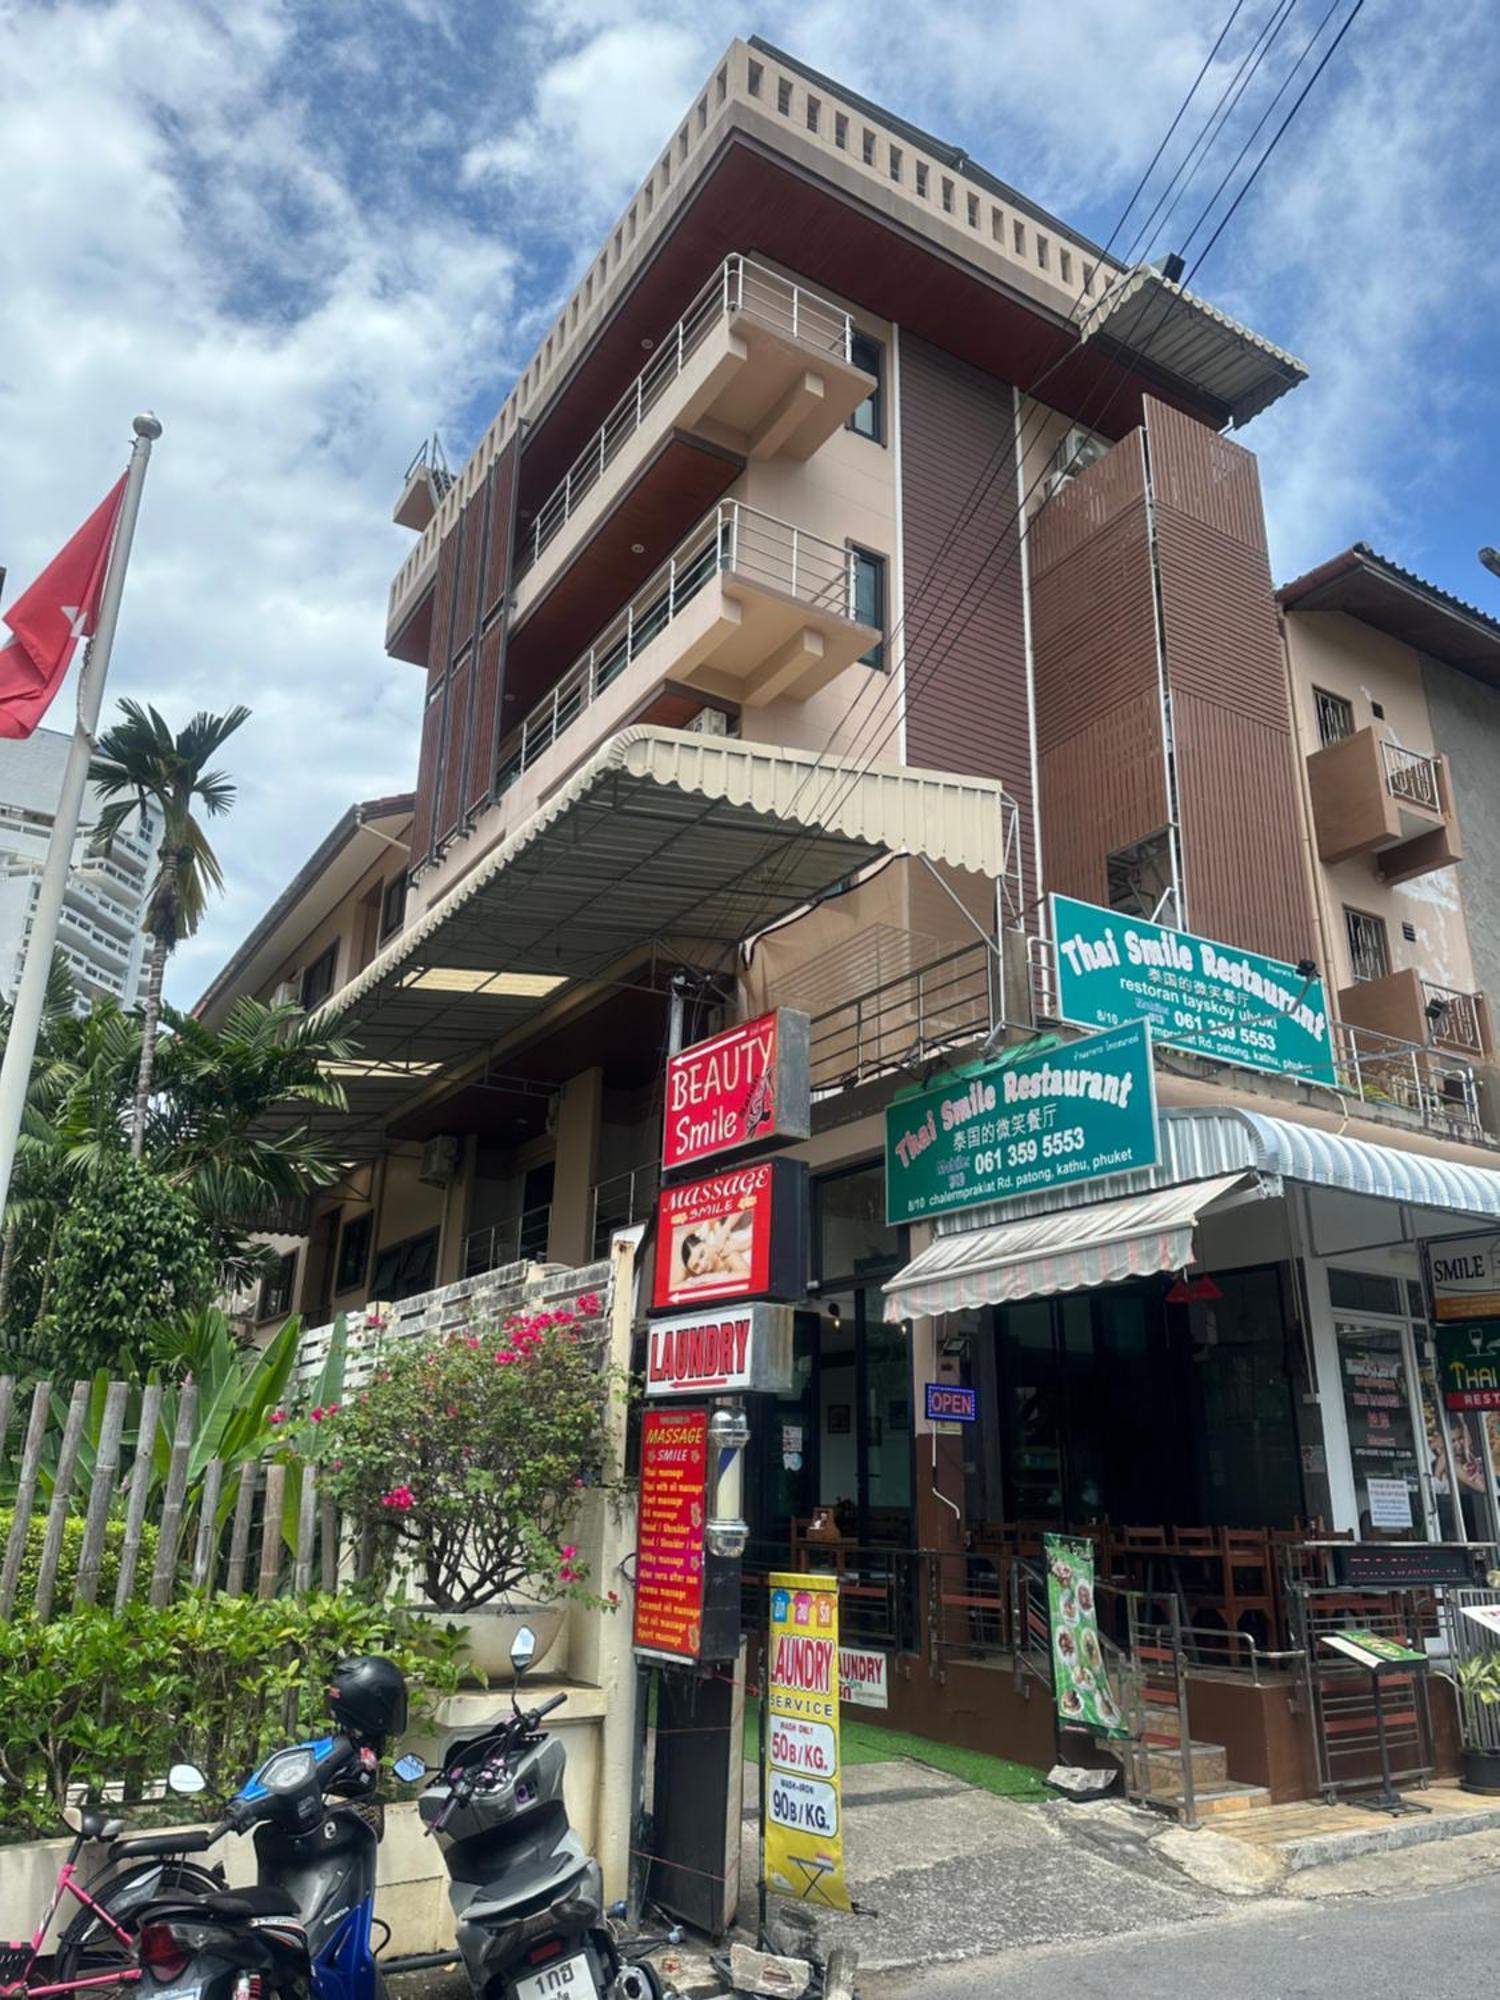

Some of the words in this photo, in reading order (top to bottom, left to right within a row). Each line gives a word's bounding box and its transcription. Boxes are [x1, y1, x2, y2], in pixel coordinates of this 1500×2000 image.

[1060, 927, 1121, 976] Thai
[1124, 929, 1194, 972] Smile
[1096, 1008, 1119, 1025] 8/10
[1119, 977, 1179, 1004] restoran
[1182, 991, 1235, 1021] tayskoy
[1173, 1010, 1203, 1031] 061
[1240, 1026, 1276, 1052] 5553
[671, 1031, 774, 1111] BEAUTY
[676, 1105, 737, 1156] Smile
[895, 1110, 937, 1168] Thai
[941, 1080, 996, 1131] Smile
[1003, 1062, 1133, 1109] Restaurant
[953, 1103, 1057, 1152] 泰国的微笑餐厅
[974, 1148, 1002, 1175] 061
[1007, 1139, 1038, 1167] 359
[1042, 1126, 1085, 1158] 5553
[997, 1176, 1013, 1190] Rd.
[1015, 1167, 1055, 1189] patong,
[1056, 1158, 1090, 1176] kathu,
[1092, 1148, 1133, 1170] phuket
[688, 1199, 734, 1220] SMILE
[1434, 1255, 1485, 1283] SMILE
[650, 1318, 750, 1383] LAUNDRY
[1449, 1361, 1498, 1390] THAI
[932, 1391, 972, 1415] OPEN
[646, 1426, 705, 1445] MASSAGE
[657, 1449, 688, 1462] SMILE
[769, 1694, 833, 1716] SERVICE
